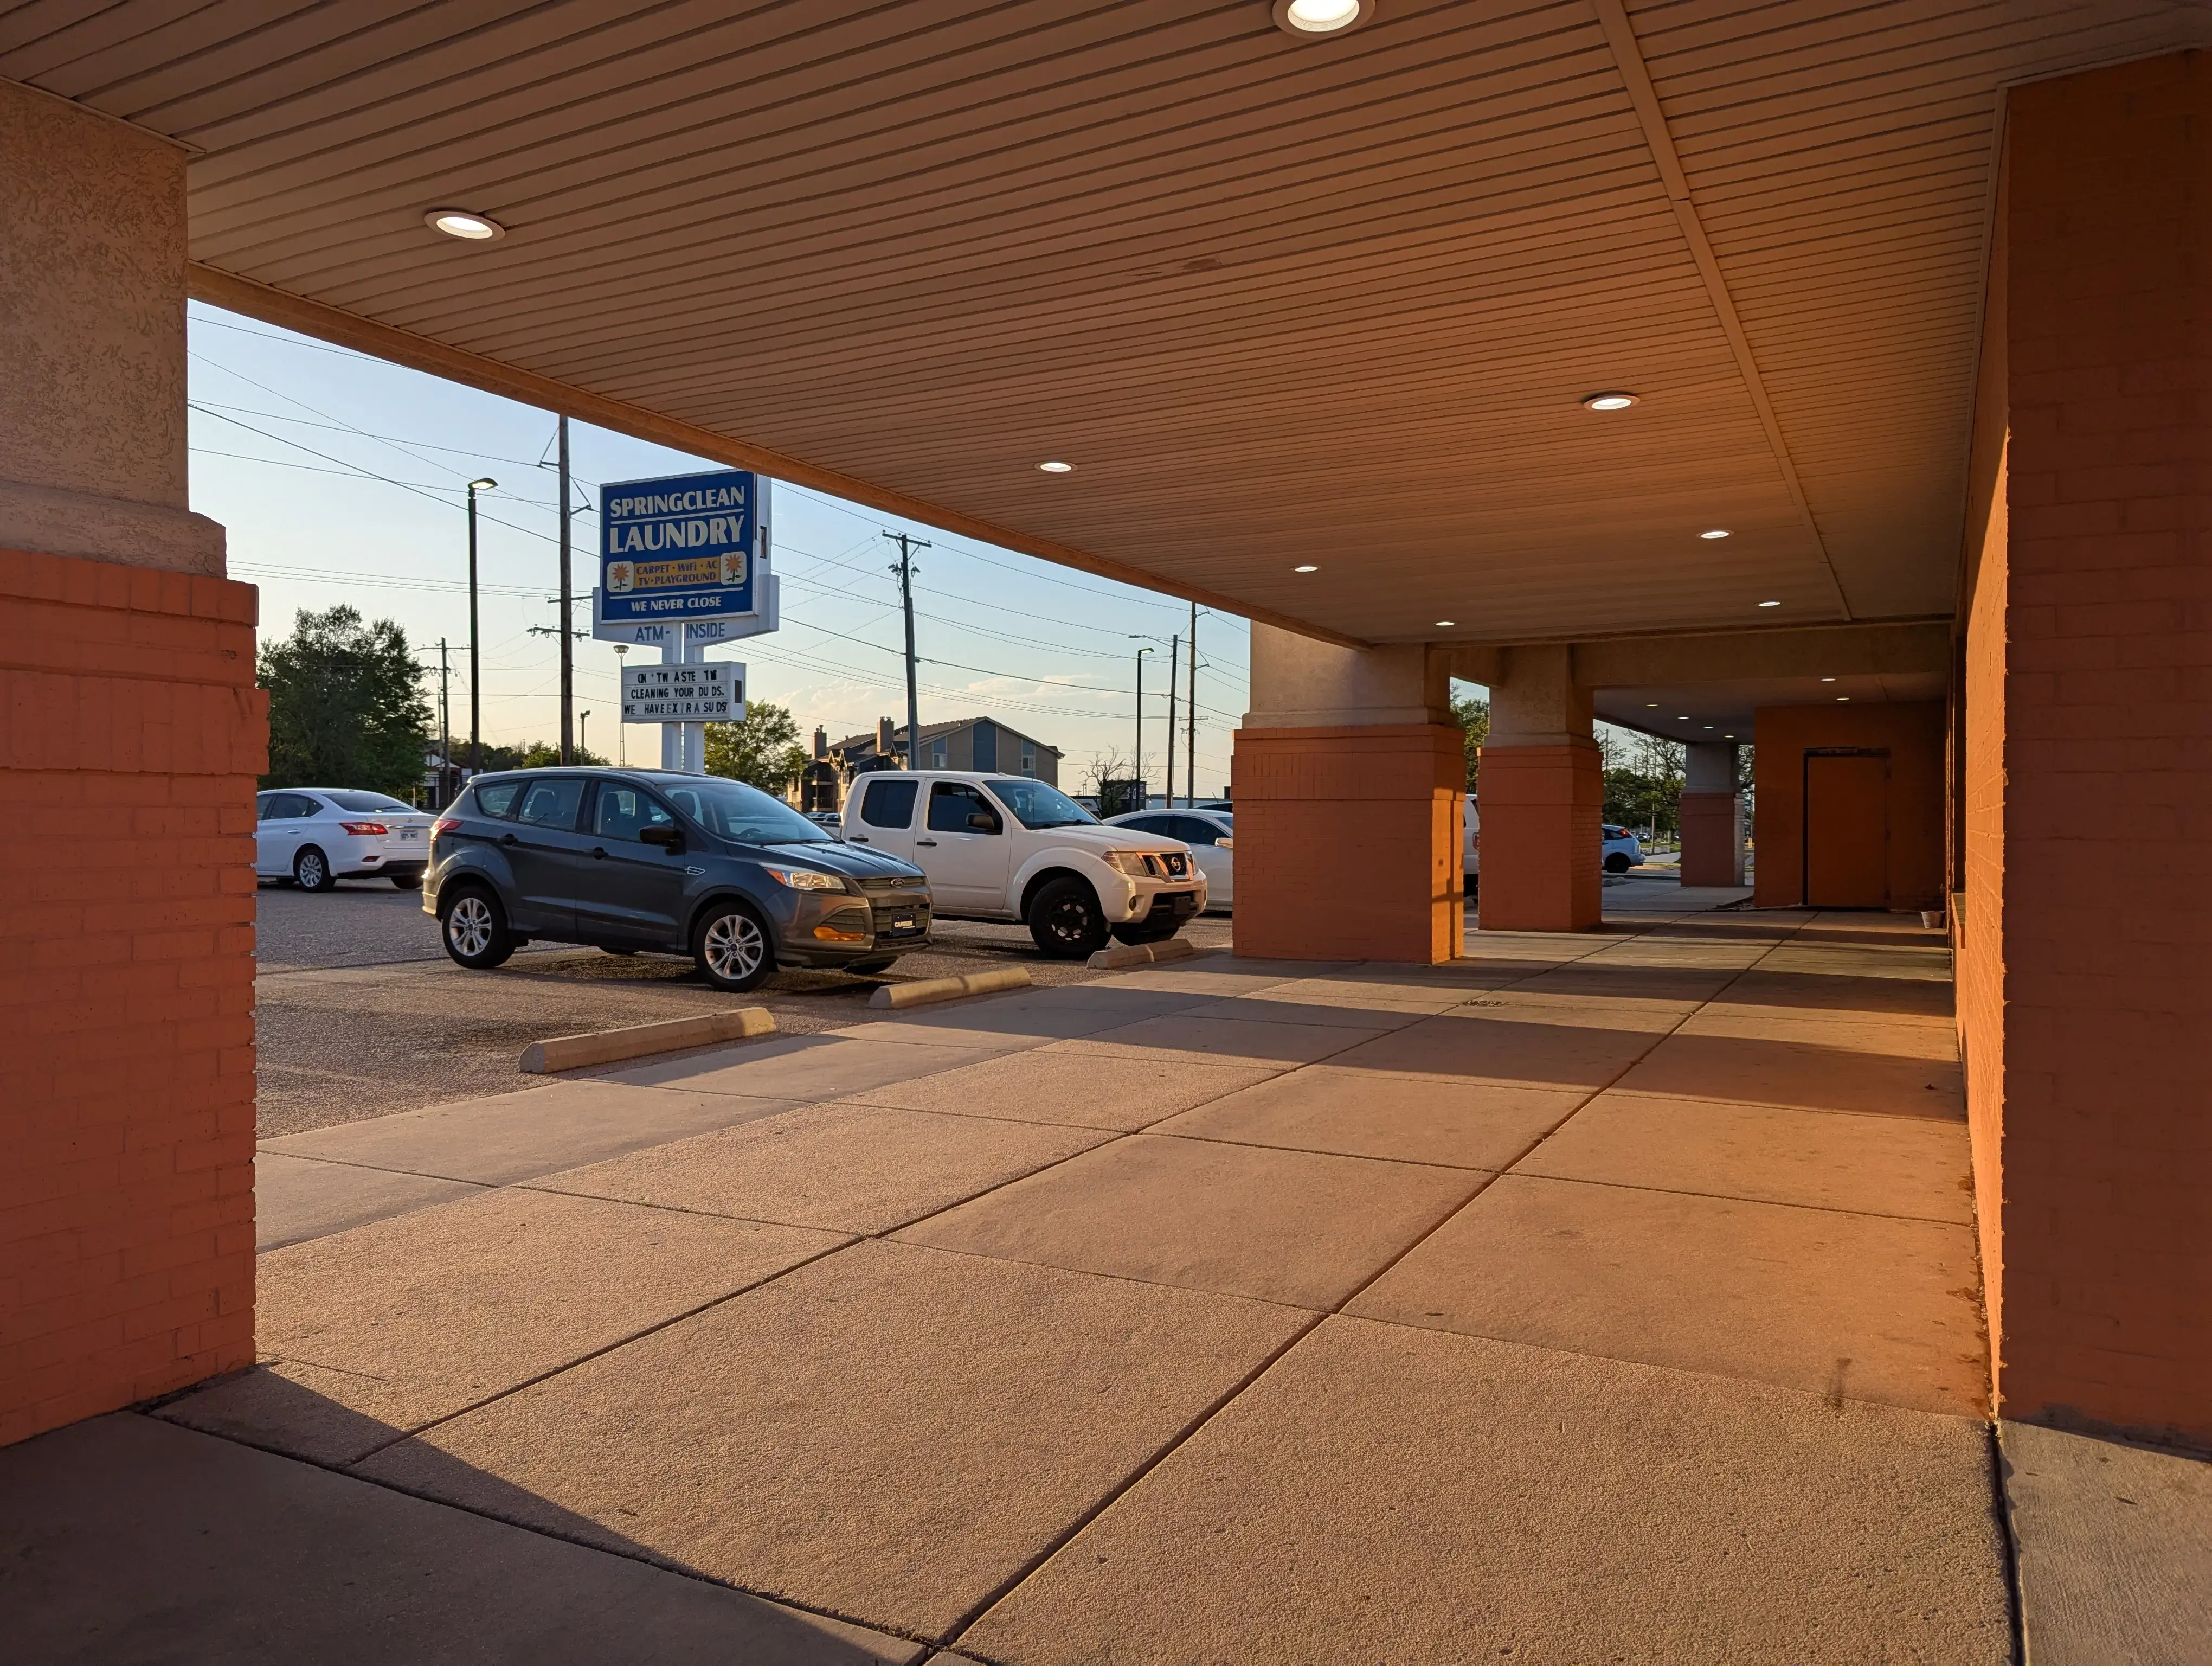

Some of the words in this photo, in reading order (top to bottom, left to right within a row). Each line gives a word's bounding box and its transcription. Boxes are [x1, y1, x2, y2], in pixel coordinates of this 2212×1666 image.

[610, 485, 744, 518] SPRINGCLEAN
[610, 515, 745, 553] LAUNDRY
[636, 565, 670, 575] CARPET
[706, 560, 718, 569] AC
[655, 572, 716, 585] PLAYGROUND
[631, 601, 647, 612] WE
[651, 599, 684, 610] NEVER
[687, 596, 722, 608] CLOSE
[686, 622, 725, 639] INSIDE
[631, 688, 669, 699] CLEANING
[674, 687, 694, 697] YOUR
[624, 704, 636, 715] WE
[644, 703, 664, 714] HAVE
